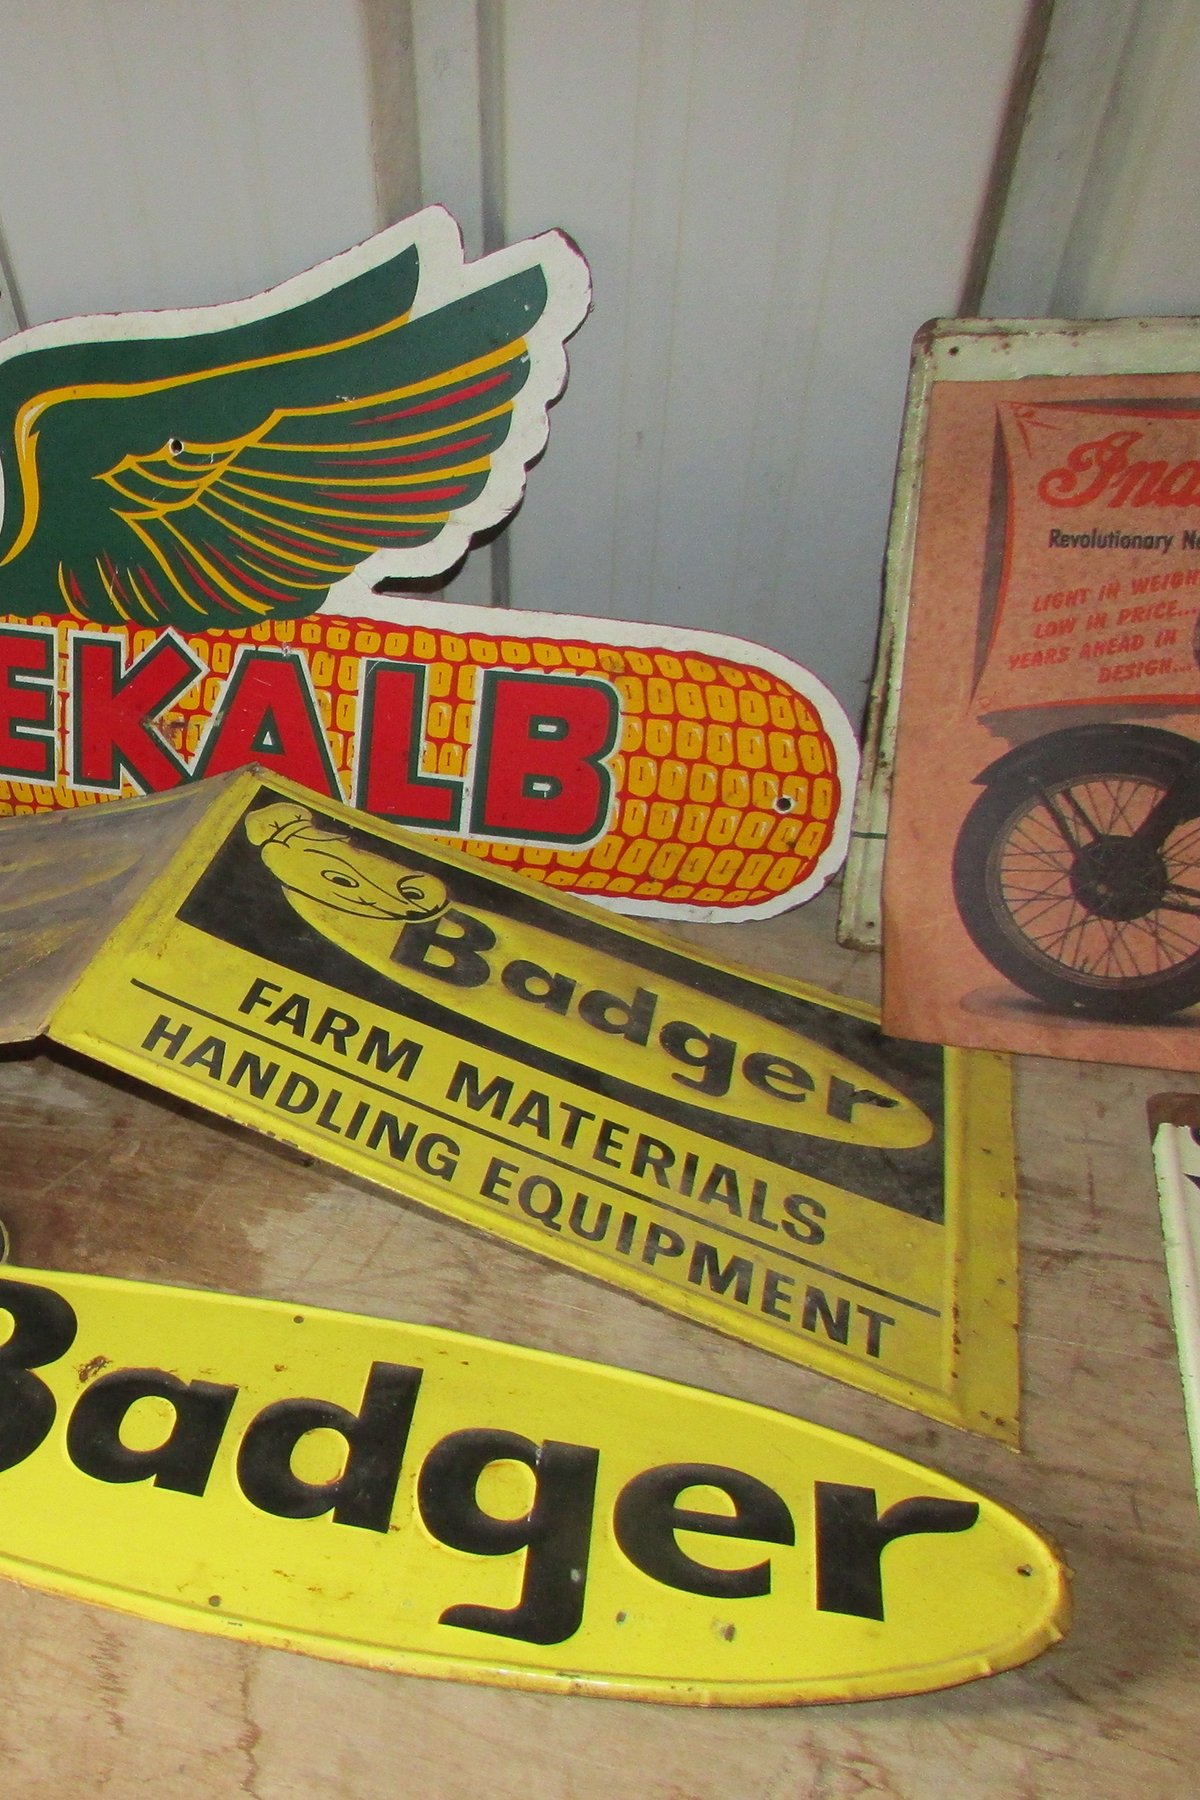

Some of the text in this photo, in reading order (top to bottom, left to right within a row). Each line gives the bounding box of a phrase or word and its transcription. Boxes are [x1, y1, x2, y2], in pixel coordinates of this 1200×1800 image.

[1049, 528, 1174, 554] Revolutionary
[1032, 588, 1090, 613] LIGHT
[1099, 580, 1121, 601] IN
[1033, 617, 1077, 639] LOW
[1086, 612, 1108, 631] IN
[1009, 629, 1178, 671] YEARS AHEAD IN
[390, 907, 899, 1123] Badger
[241, 979, 827, 1246] FARM MATERIALS
[143, 1015, 896, 1358] HANDLING EQUIPMENT
